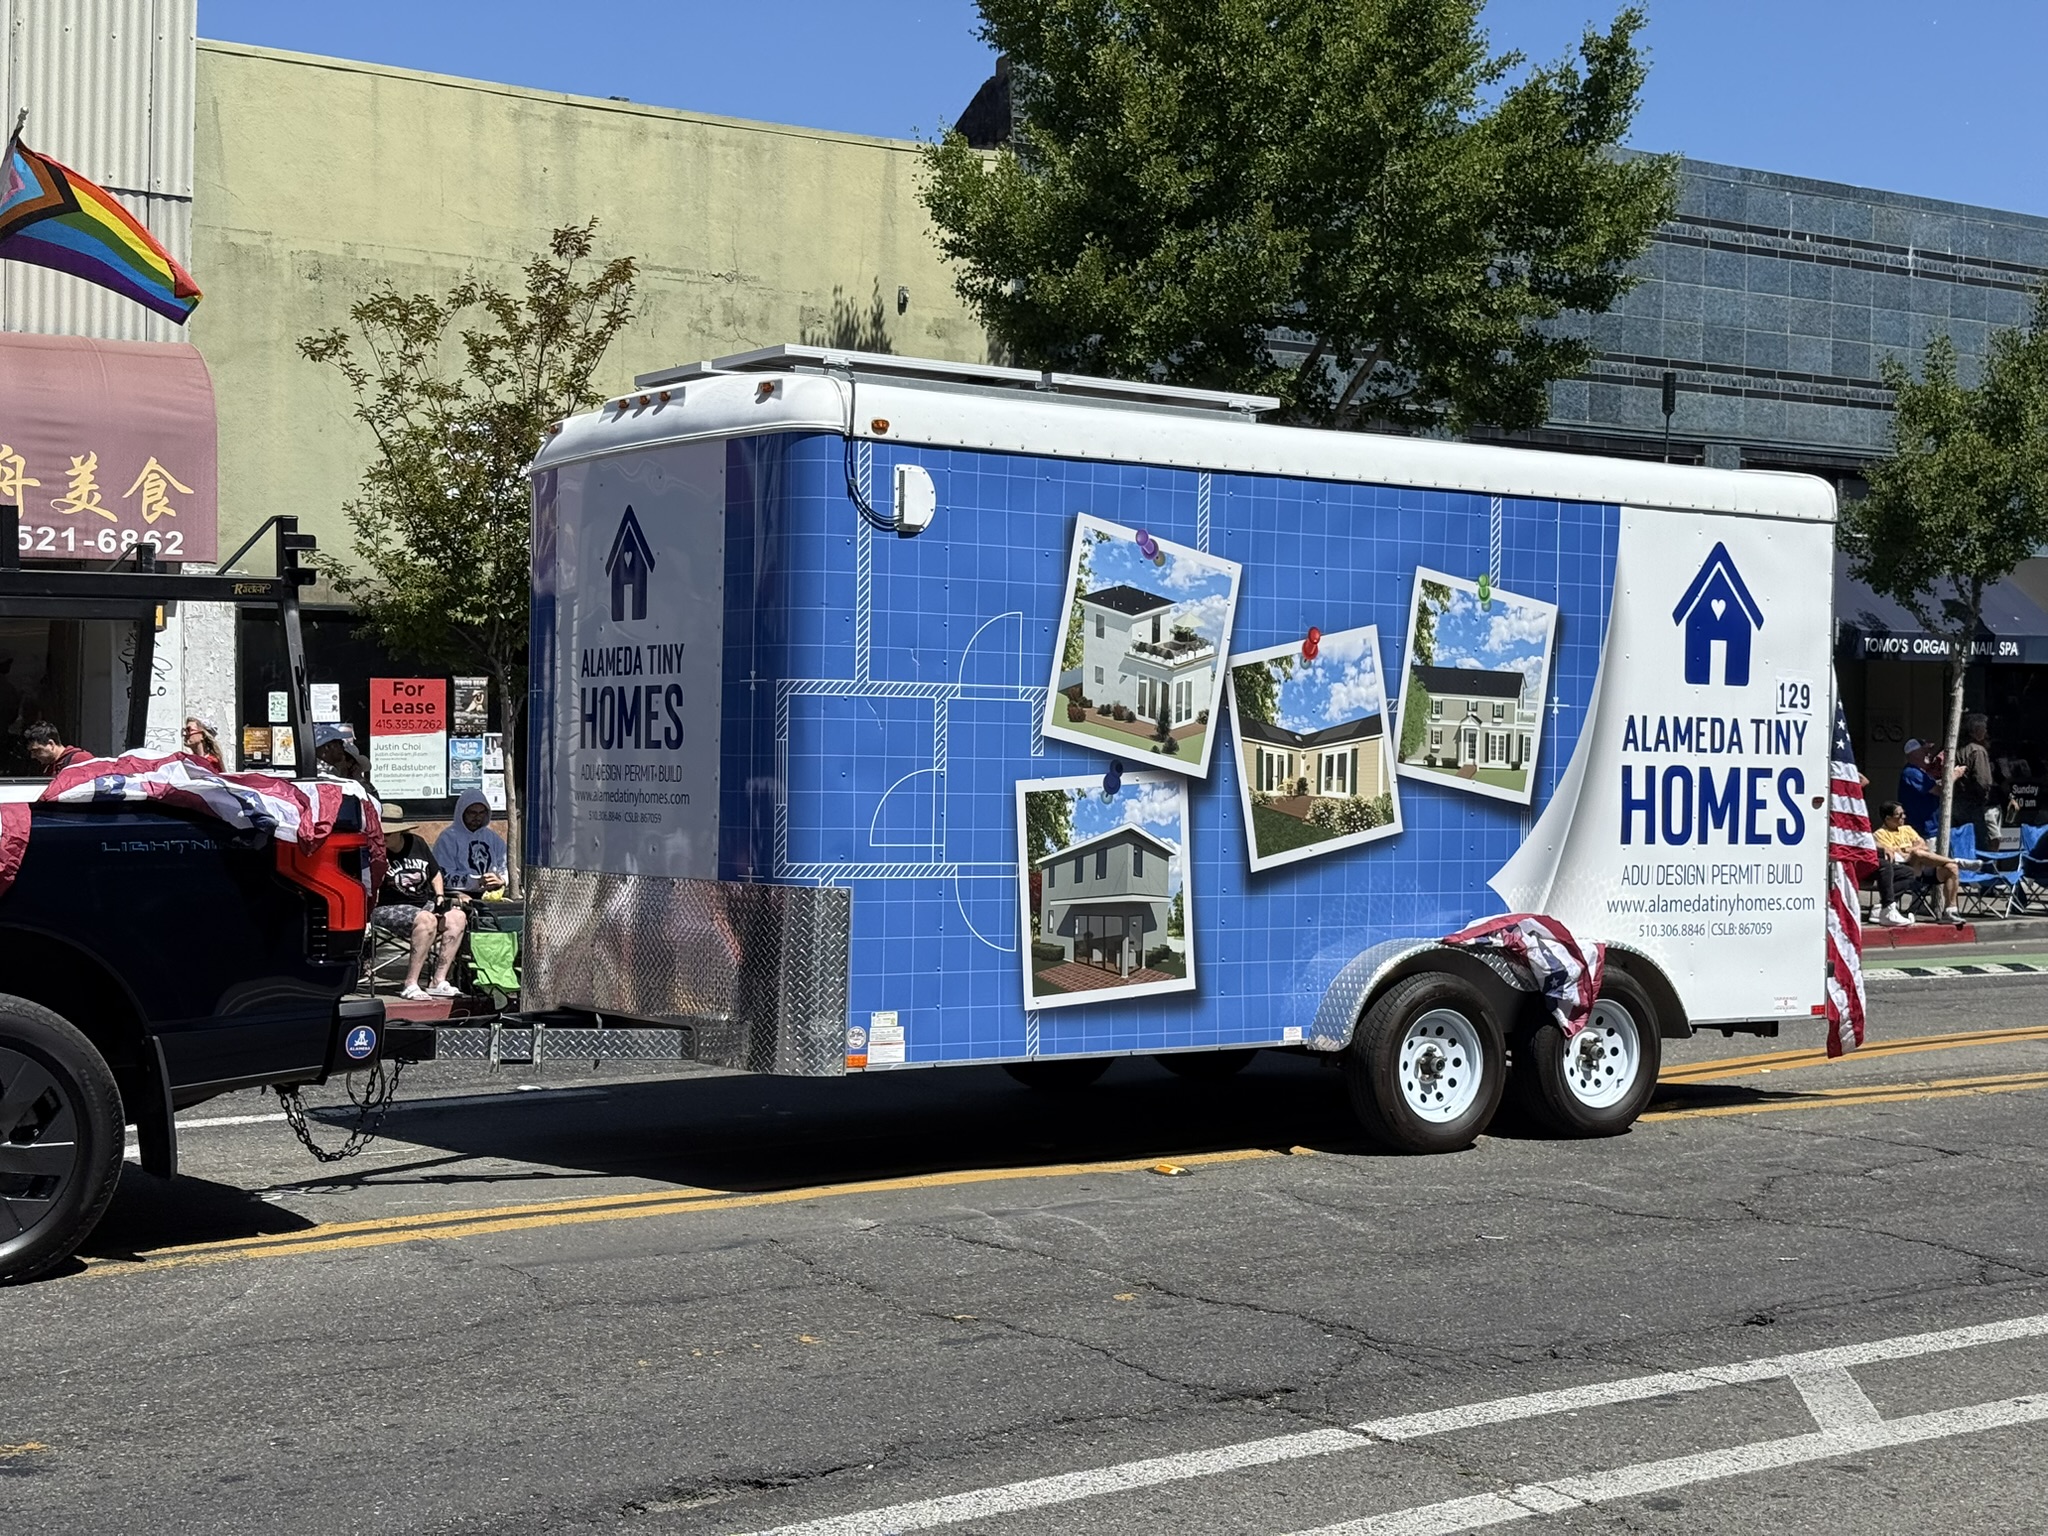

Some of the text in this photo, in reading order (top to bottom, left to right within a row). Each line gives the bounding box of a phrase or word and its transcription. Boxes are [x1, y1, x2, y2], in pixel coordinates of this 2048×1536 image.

[18, 525, 184, 555] 521-6862
[1864, 637, 1908, 654] TOMO'S
[1970, 641, 1995, 656] NAIL
[1998, 641, 2018, 656] SPA
[581, 643, 685, 678] ALAMEDA TINY
[393, 681, 425, 697] For
[1779, 682, 1811, 709] 129
[381, 699, 436, 715] Lease
[580, 683, 684, 750] HOMES
[375, 719, 442, 730] 415.395.7262
[1622, 715, 1808, 755] ALAMEDA TINY
[374, 742, 422, 751] Justin Choi
[599, 764, 622, 781] DESIGN
[624, 764, 656, 782] PERMIT
[658, 765, 683, 783] BUILD
[2012, 784, 2039, 796] Sunday
[1620, 765, 1806, 846] HOMES
[2025, 799, 2036, 807] am
[101, 839, 217, 854] LIGHTNI
[1621, 863, 1803, 886] ADU DESIGN PERMIT BUILD
[1606, 893, 1816, 916] www.alamedatinyhomes.com
[1638, 924, 1706, 937] 510.306.8846
[1738, 922, 1773, 936] 867059
